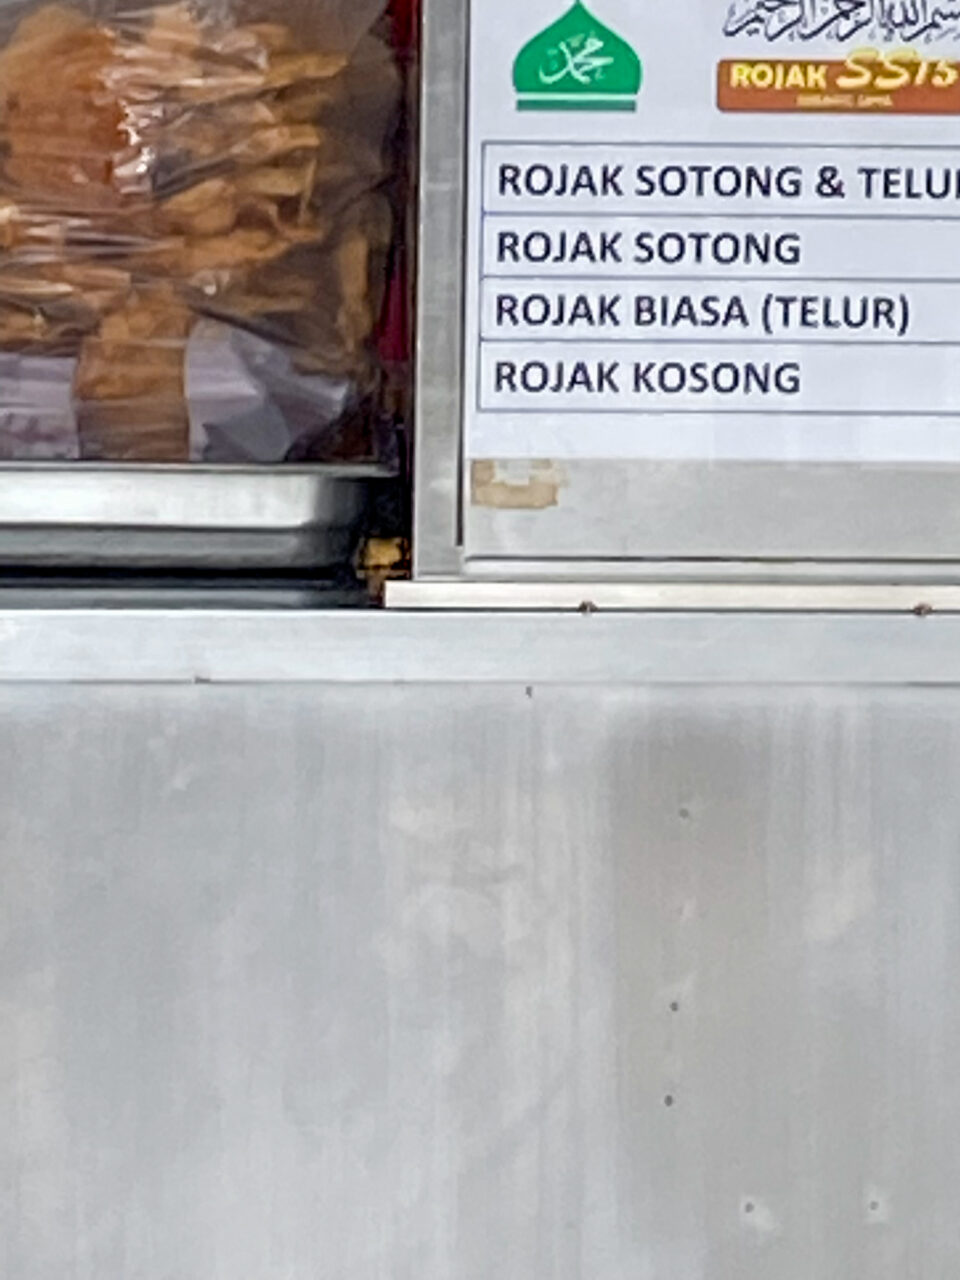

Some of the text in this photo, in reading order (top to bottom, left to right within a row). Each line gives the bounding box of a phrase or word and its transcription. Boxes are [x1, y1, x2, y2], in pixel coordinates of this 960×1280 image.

[729, 62, 828, 90] ROJAK
[499, 164, 623, 199] ROJAK
[635, 165, 802, 197] SOTONG
[815, 165, 845, 199] &
[497, 231, 800, 265] ROJAK SOTONG
[496, 293, 909, 336] ROJAK BIASA (TELUR)
[495, 361, 800, 394] ROJAK KOSONG
